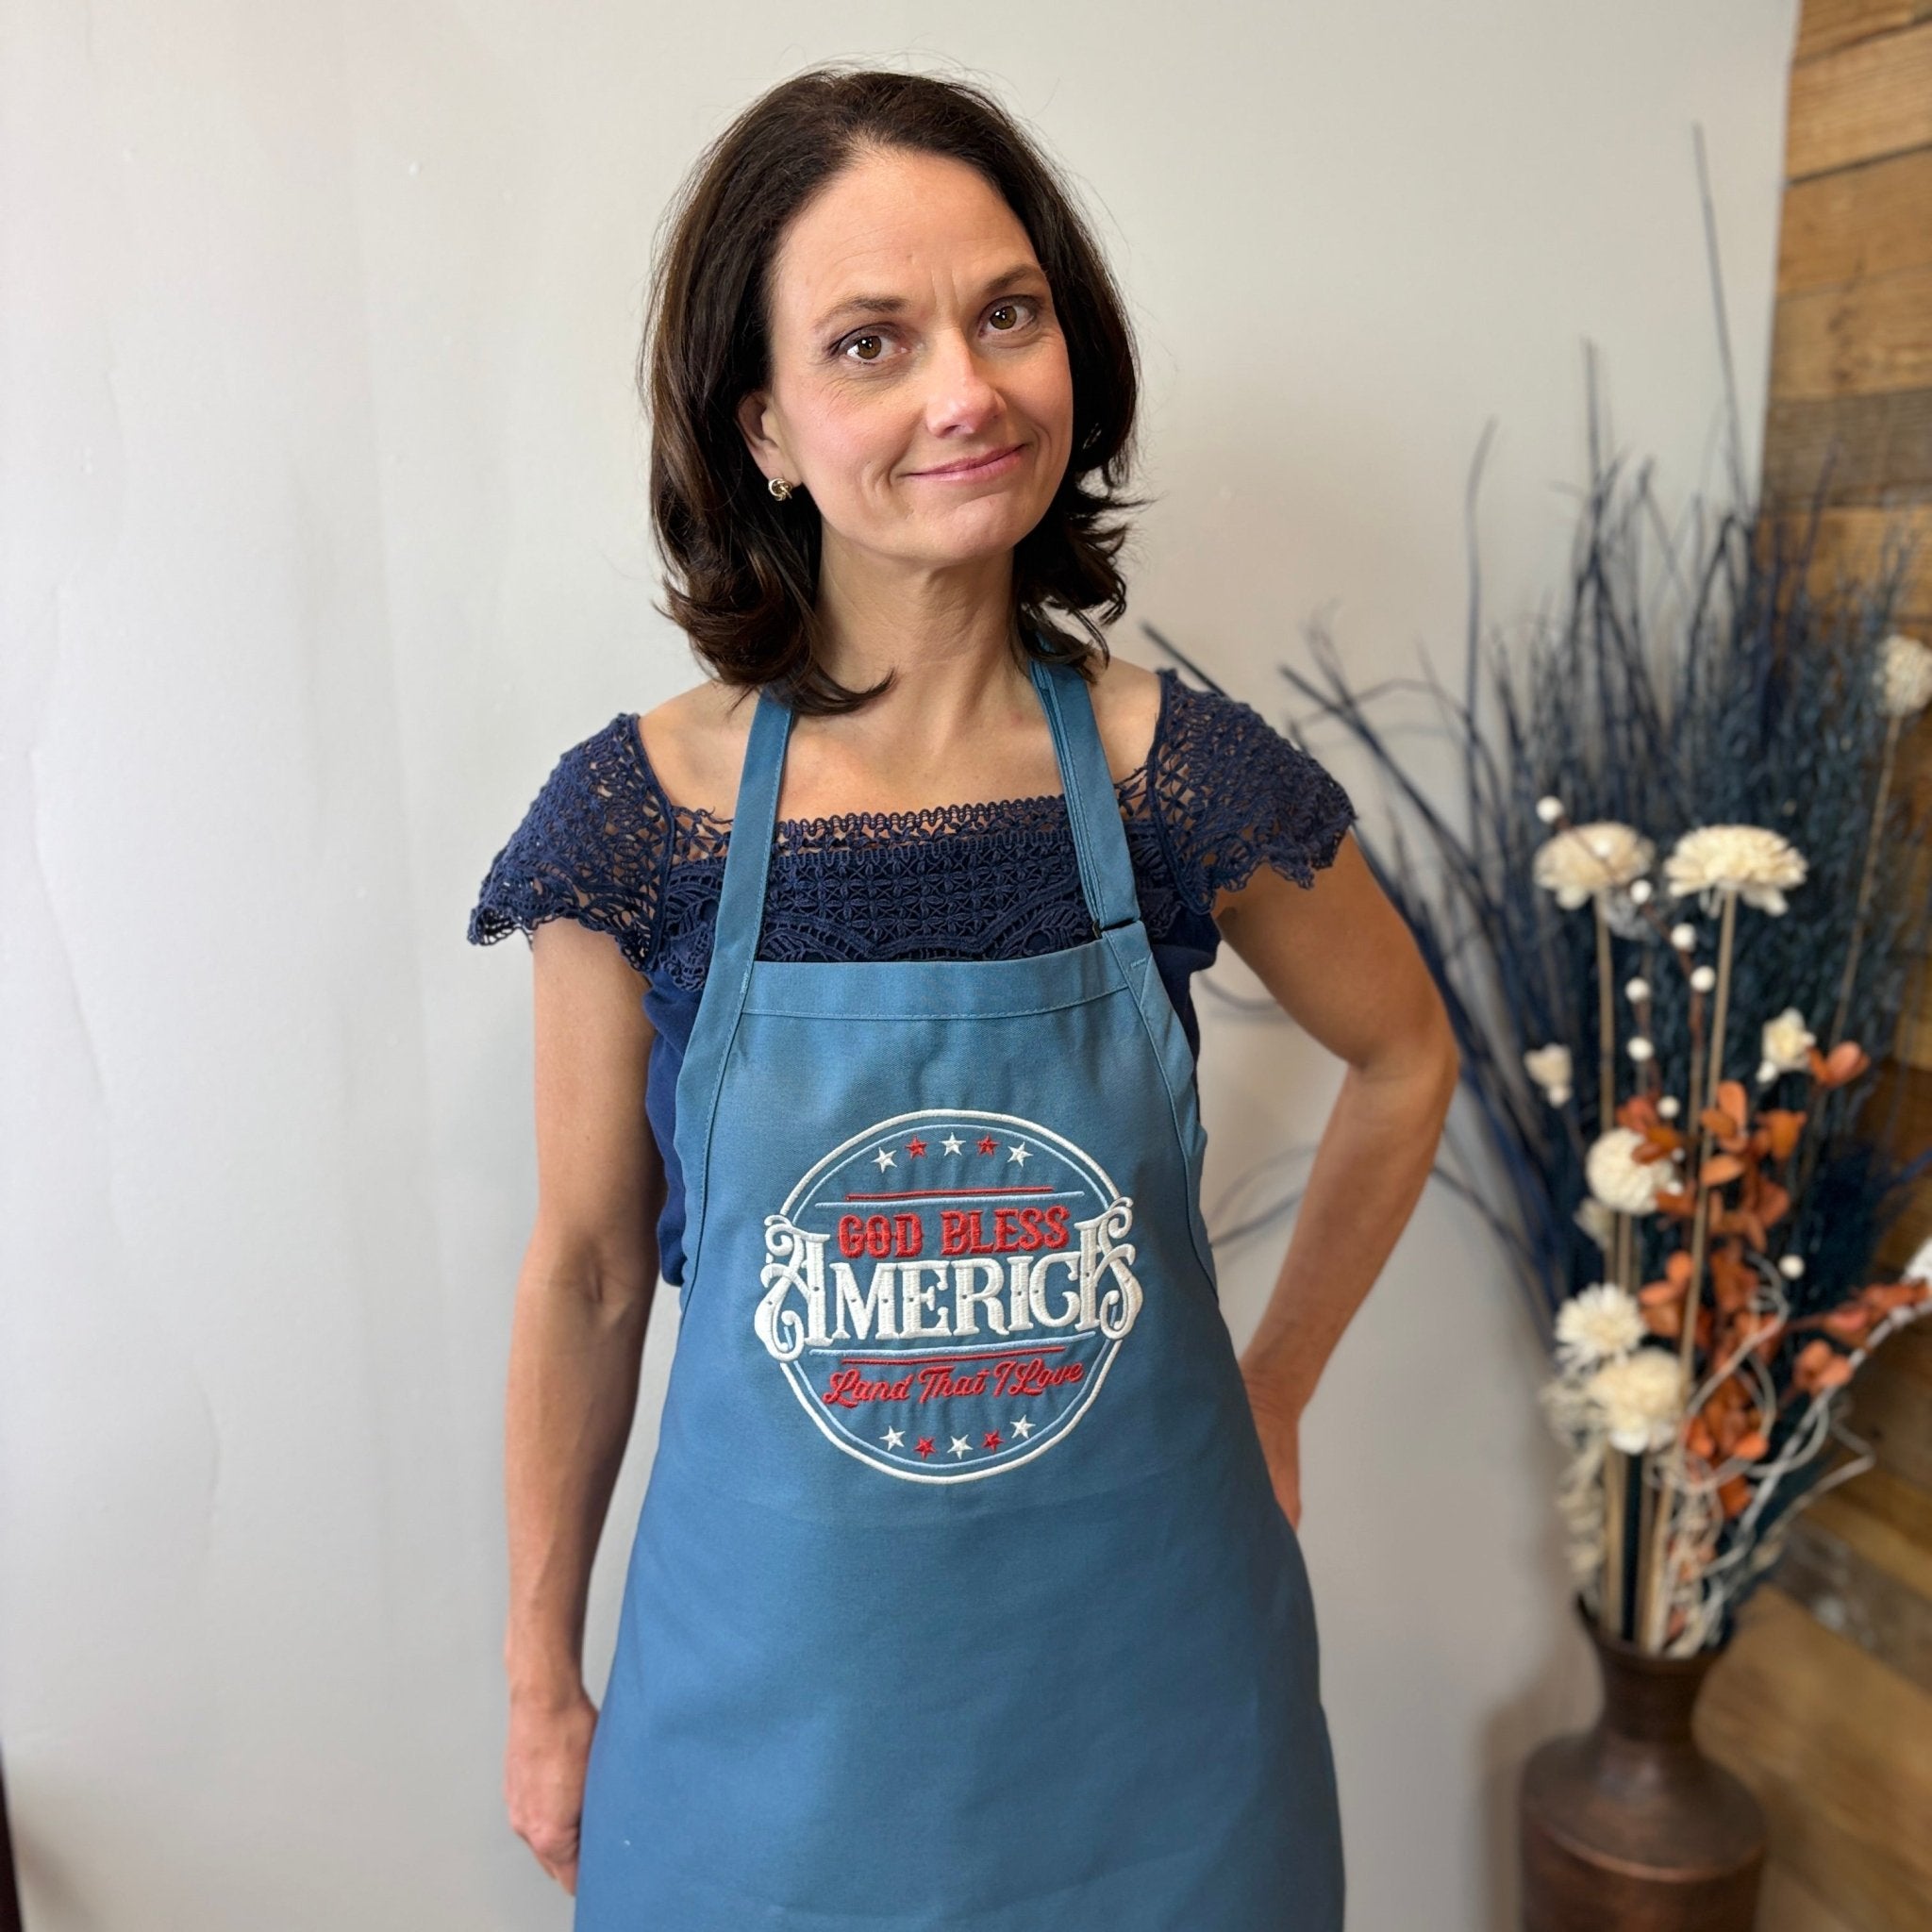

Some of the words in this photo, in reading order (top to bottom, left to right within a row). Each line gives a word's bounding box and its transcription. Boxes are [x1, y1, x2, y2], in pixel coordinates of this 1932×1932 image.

[838, 1213, 923, 1258] GOD
[940, 1205, 1071, 1257] BLESS
[823, 1367, 914, 1407] Land
[919, 1365, 990, 1404] That
[1008, 1357, 1085, 1397] Love
